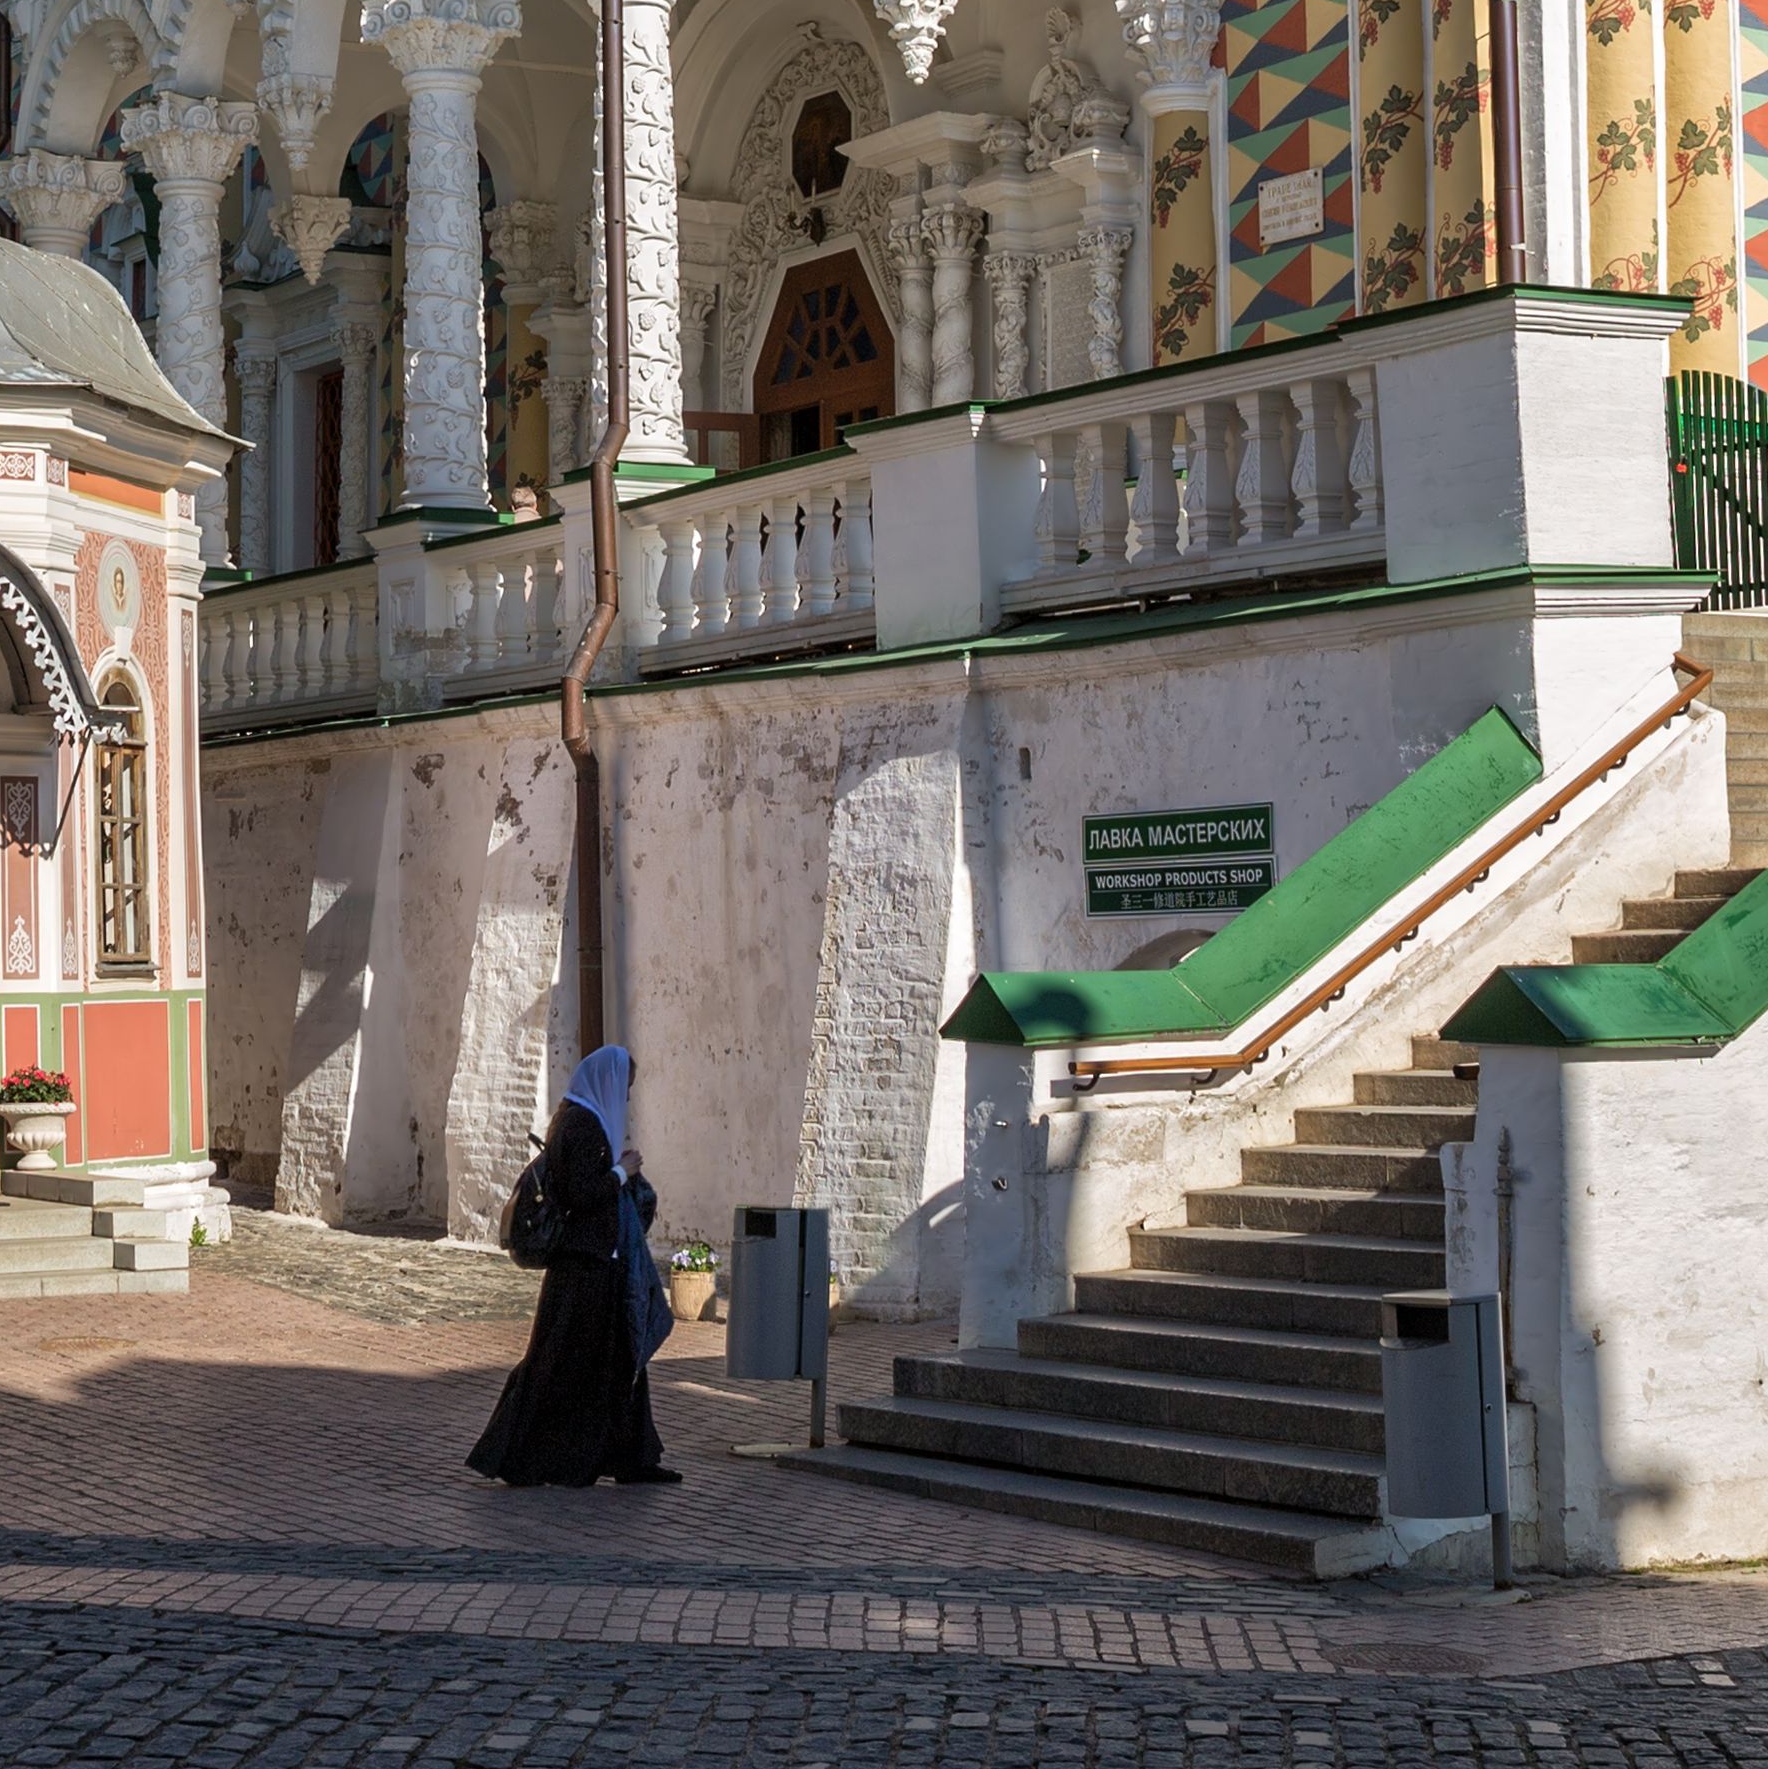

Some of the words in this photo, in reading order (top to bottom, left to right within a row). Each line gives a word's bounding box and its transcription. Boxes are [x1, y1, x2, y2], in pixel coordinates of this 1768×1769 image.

[1089, 826, 1143, 850] ЛАВКА
[1148, 818, 1265, 846] МАСТЕРСКИХ
[1095, 873, 1162, 889] WORKSHOP
[1165, 870, 1227, 886] PRODUCTS
[1231, 868, 1263, 883] SHOP
[1120, 890, 1238, 910] 圣三一修道院手工艺品店
